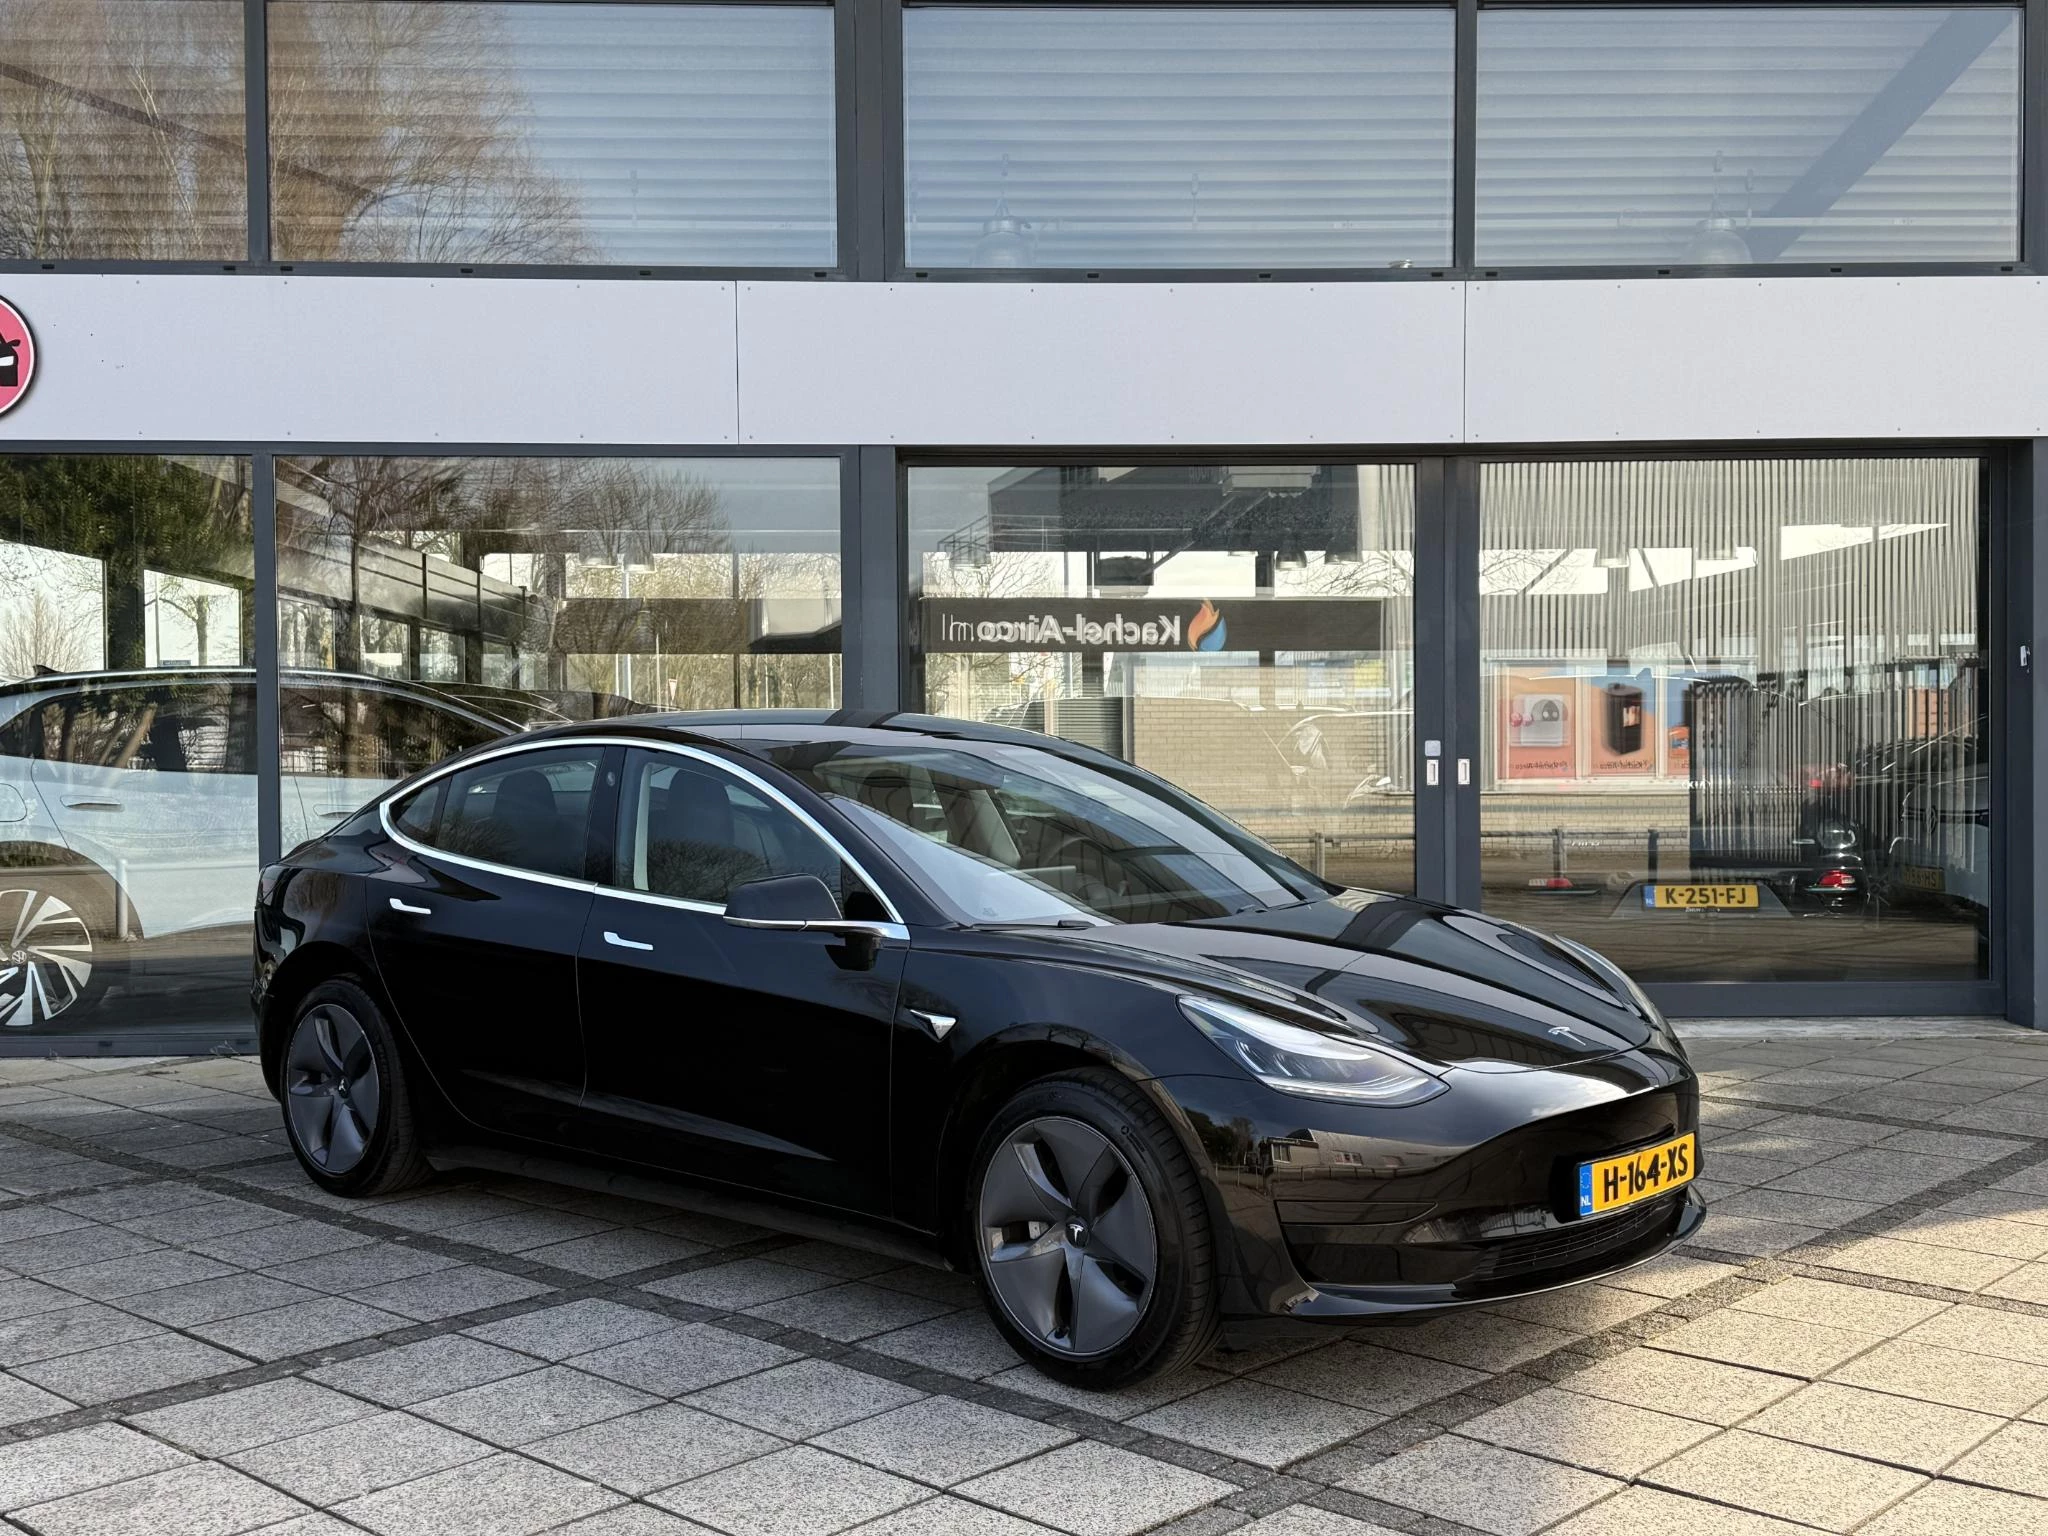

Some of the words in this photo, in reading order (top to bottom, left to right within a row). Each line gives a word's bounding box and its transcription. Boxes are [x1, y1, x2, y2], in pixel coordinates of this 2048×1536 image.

[1665, 887, 1746, 904] K-251-FJ
[1604, 1143, 1688, 1203] H-164-XS
[1580, 1195, 1591, 1207] NL
